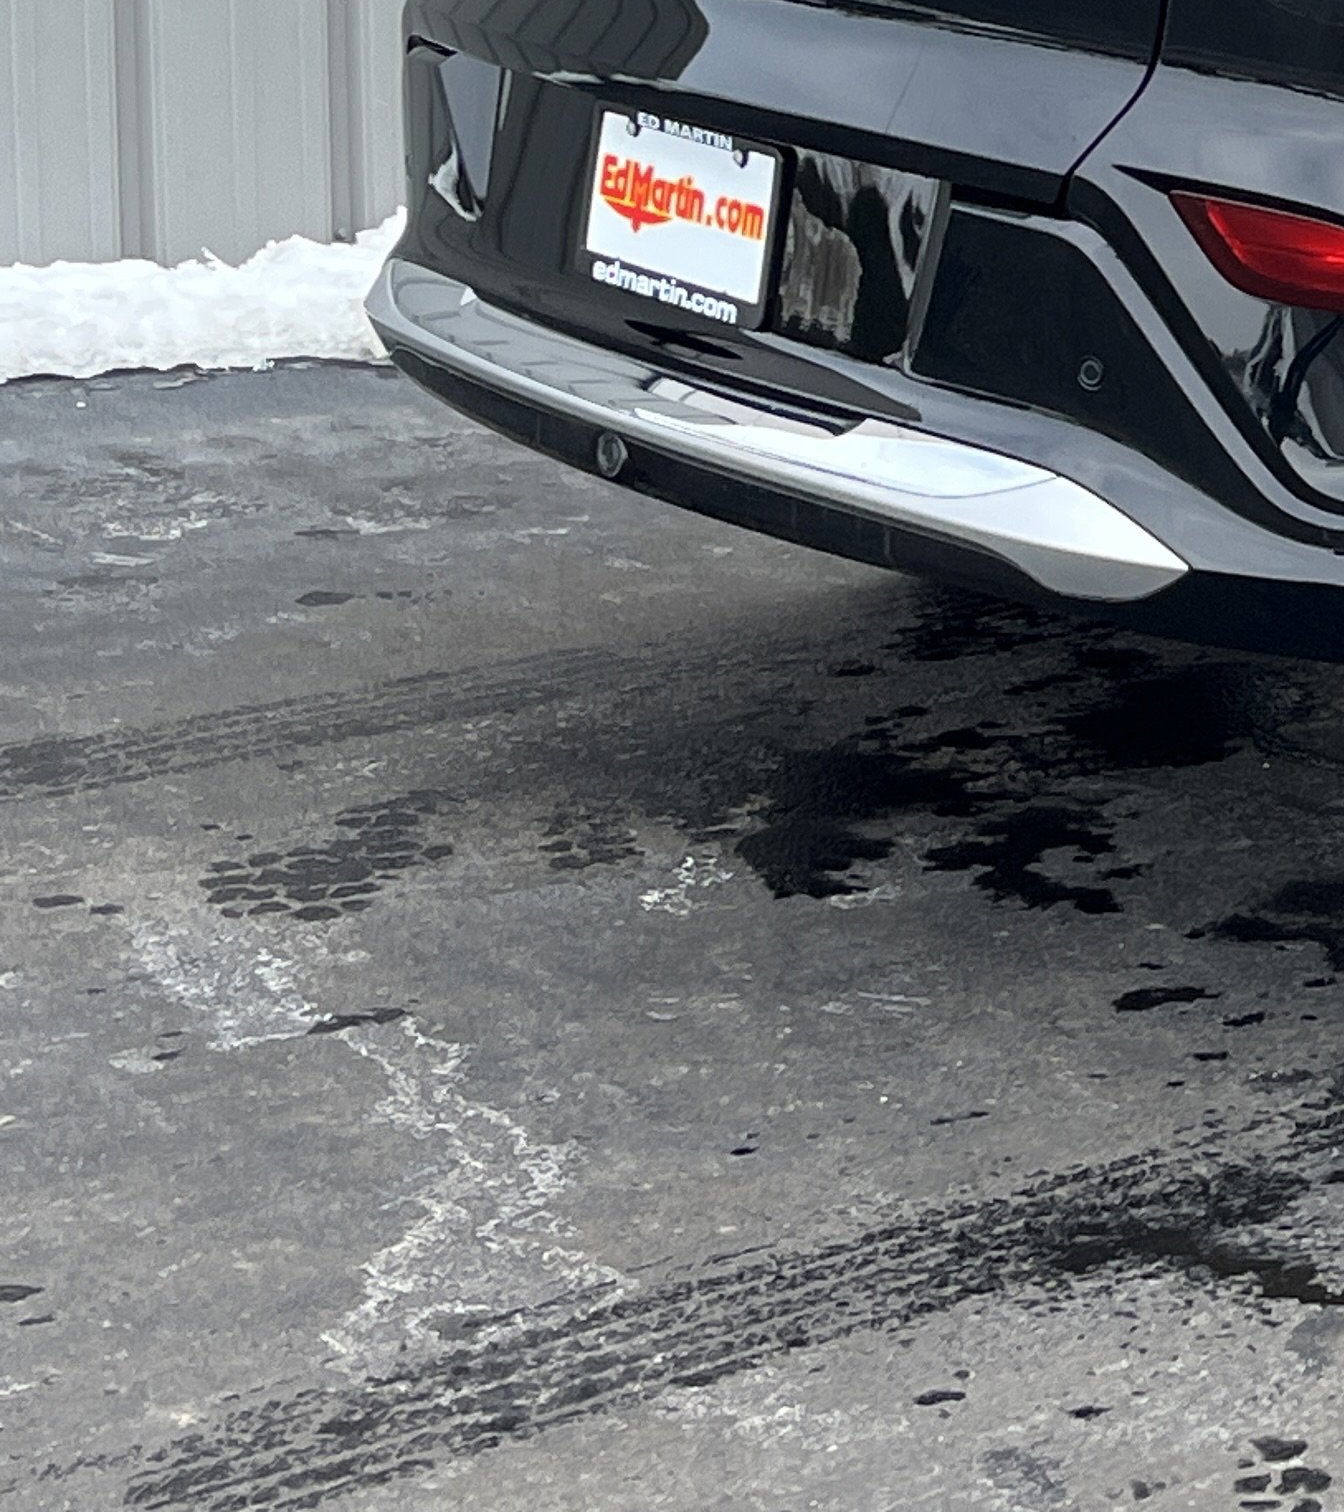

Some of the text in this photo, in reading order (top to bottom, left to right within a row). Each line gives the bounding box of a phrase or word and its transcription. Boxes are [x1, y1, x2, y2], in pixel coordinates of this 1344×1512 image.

[637, 111, 733, 152] ED MARTIN
[600, 153, 764, 241] EdMartin.com
[592, 260, 738, 324] edmartin.com
